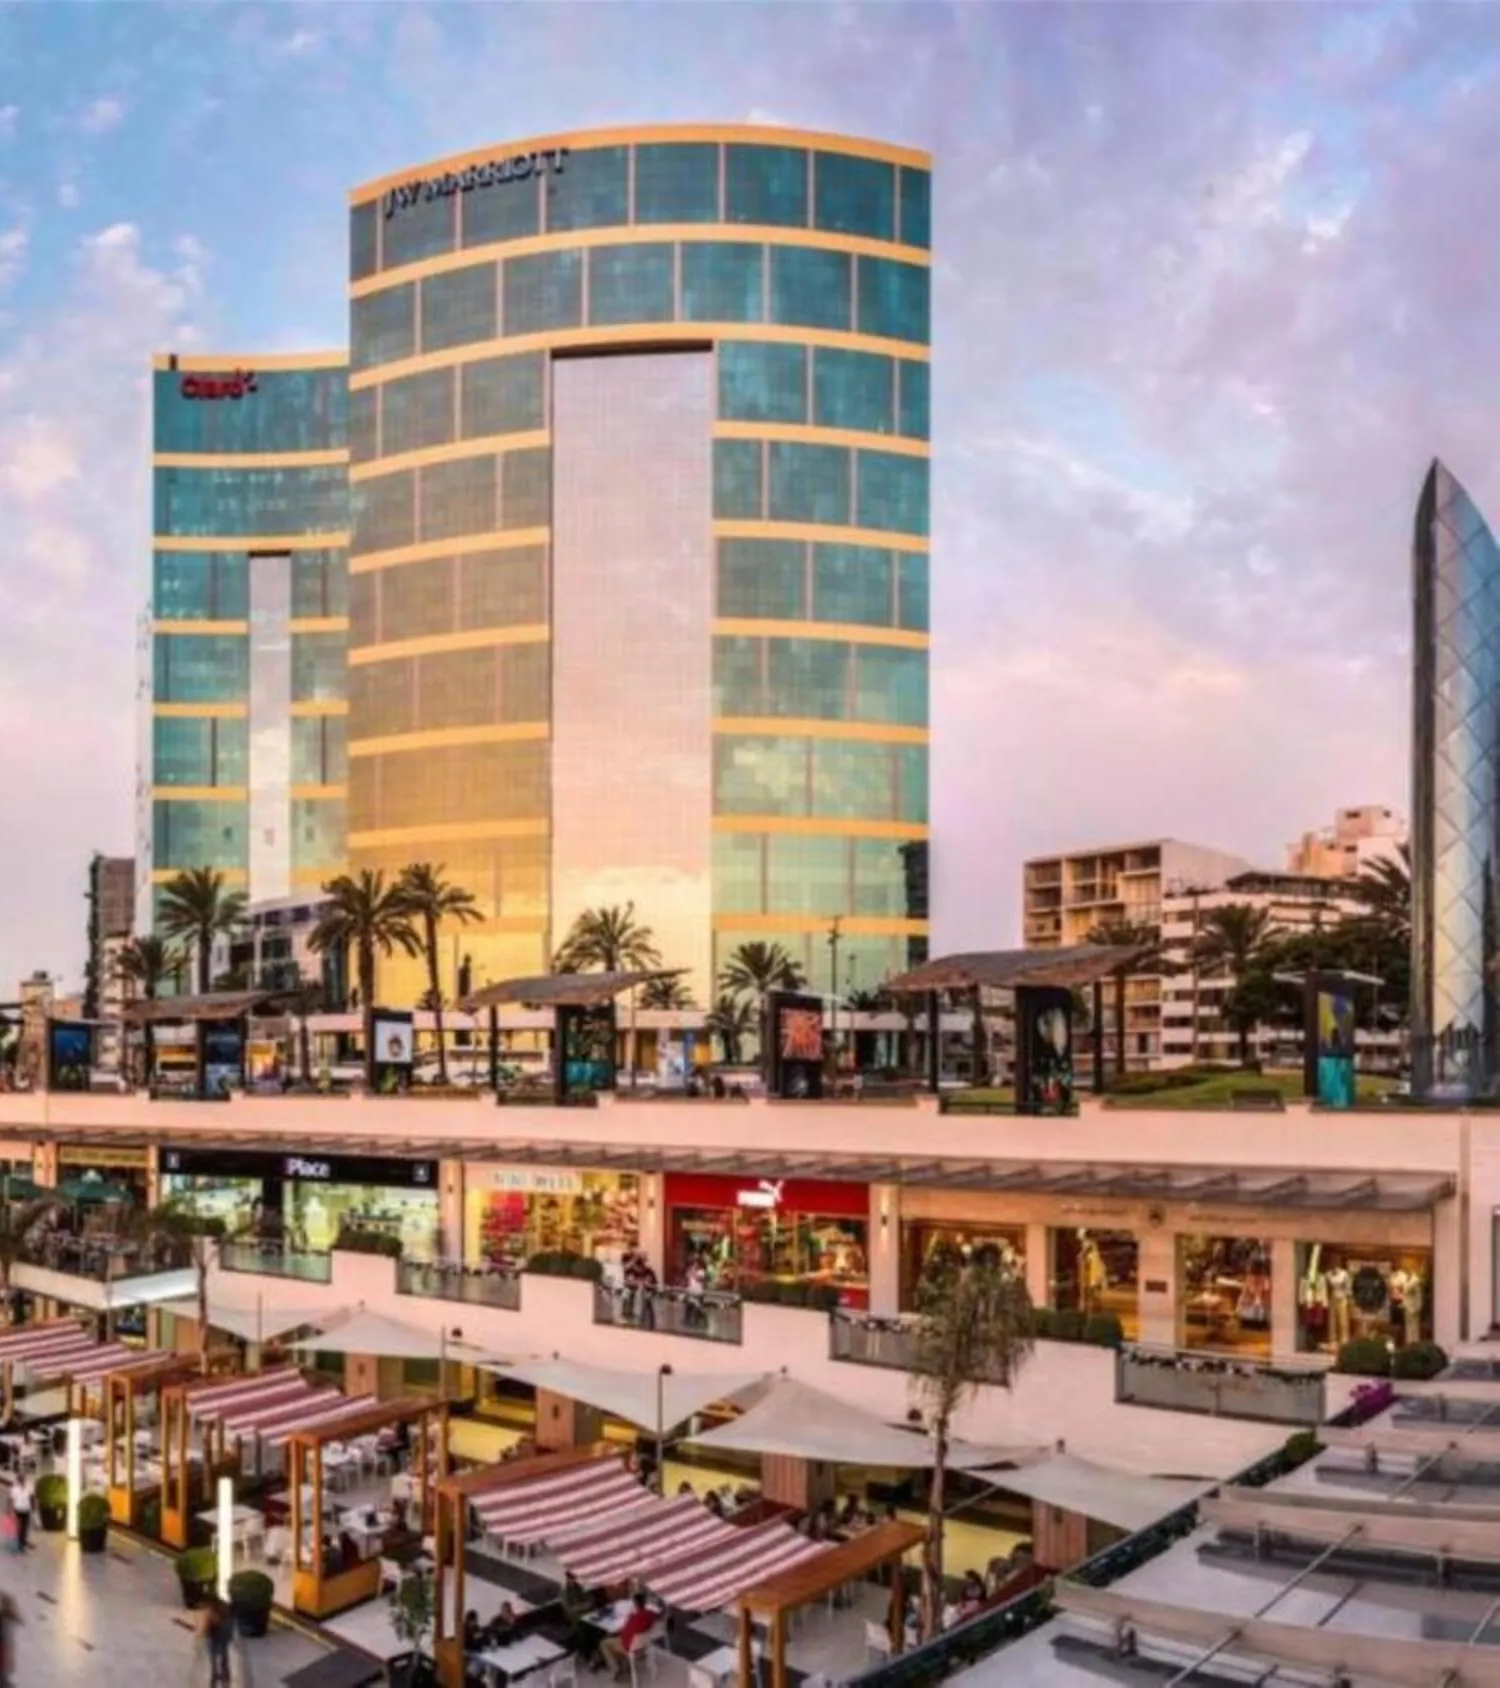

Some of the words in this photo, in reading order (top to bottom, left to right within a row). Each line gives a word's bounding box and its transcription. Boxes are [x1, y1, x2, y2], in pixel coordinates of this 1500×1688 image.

[384, 181, 423, 219] JW
[425, 147, 569, 202] MARRIOTT
[286, 1157, 330, 1178] Place
